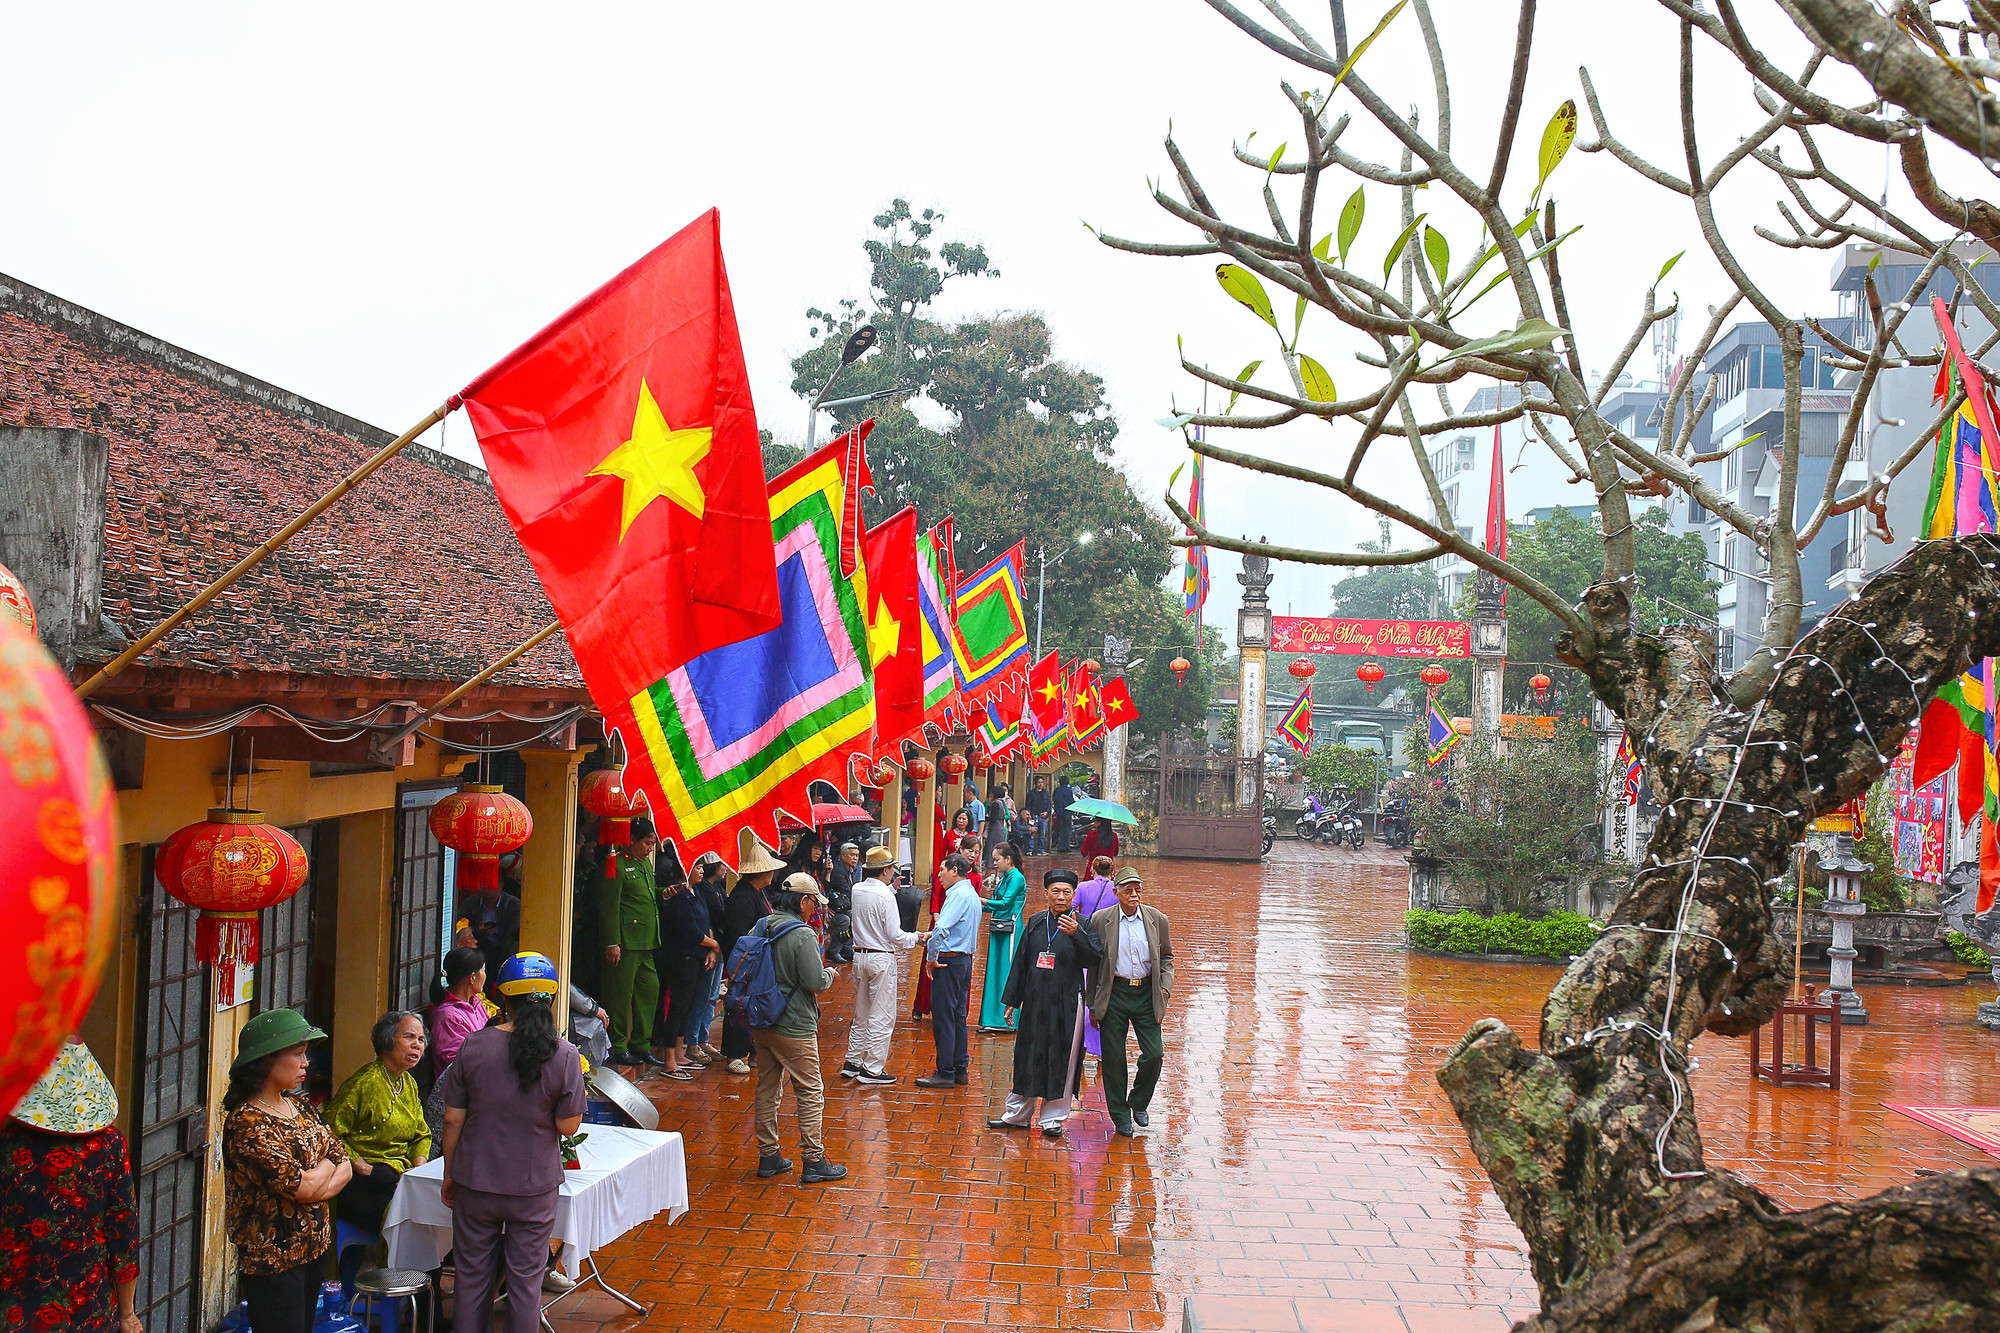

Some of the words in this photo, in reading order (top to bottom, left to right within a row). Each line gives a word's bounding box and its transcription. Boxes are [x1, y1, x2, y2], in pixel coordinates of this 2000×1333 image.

[1299, 620, 1330, 643] Chúc
[1333, 622, 1373, 653] Mừng
[1377, 623, 1412, 645] Năm
[1436, 645, 1464, 657] 2026
[474, 817, 507, 837] Phát
